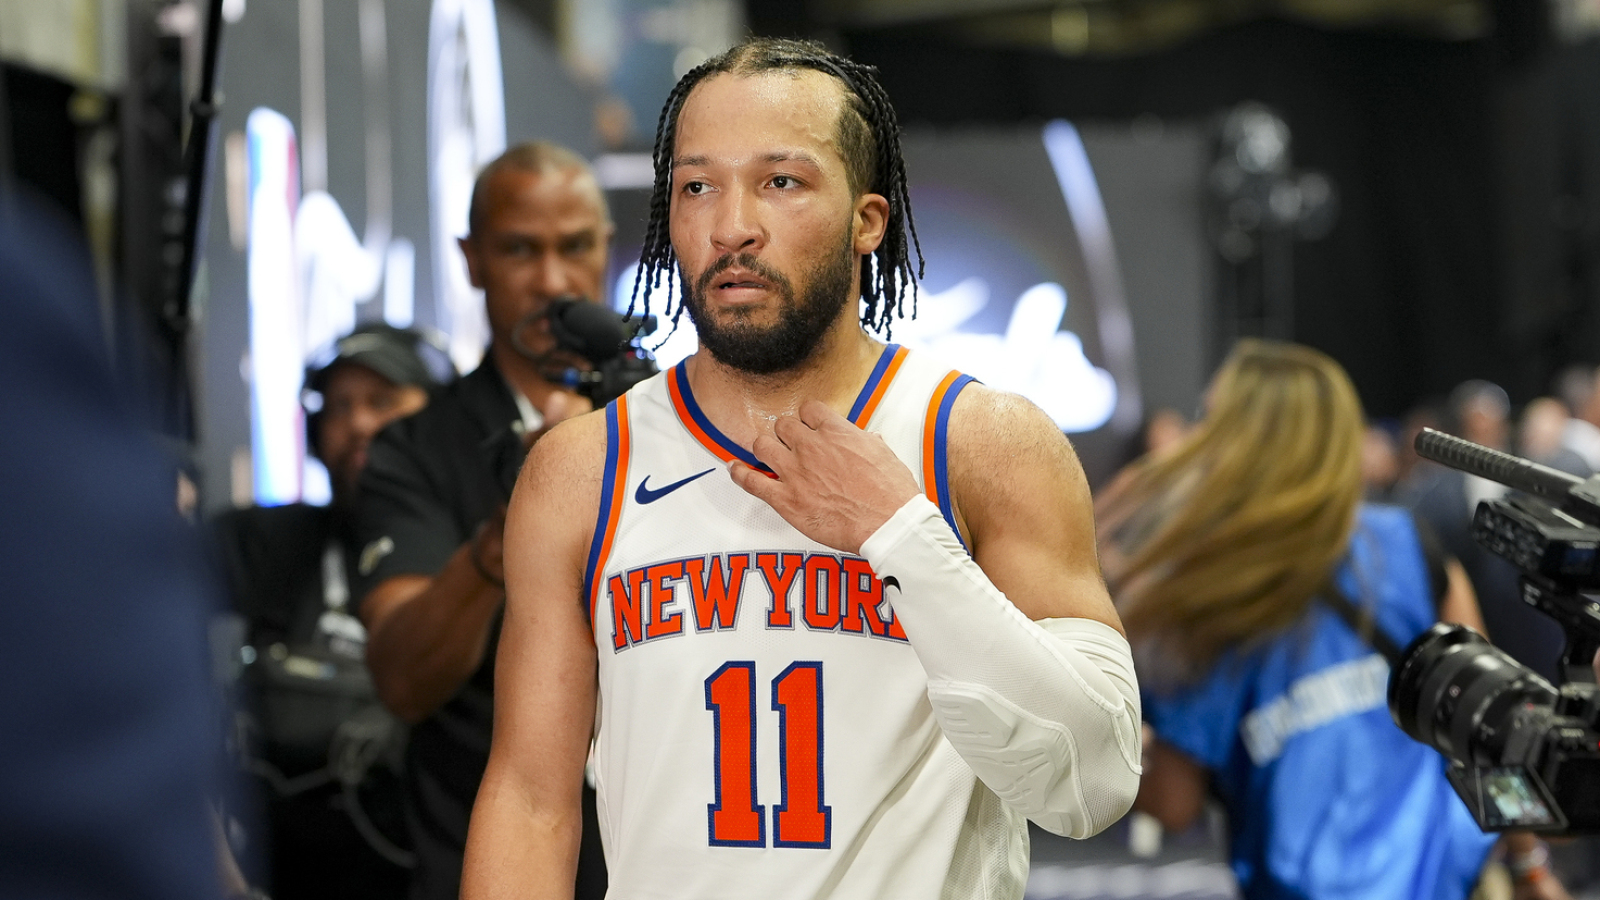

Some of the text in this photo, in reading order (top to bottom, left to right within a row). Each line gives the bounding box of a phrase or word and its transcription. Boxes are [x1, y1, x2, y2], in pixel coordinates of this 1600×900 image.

[607, 550, 911, 654] NEW YOR
[704, 660, 831, 850] 11
